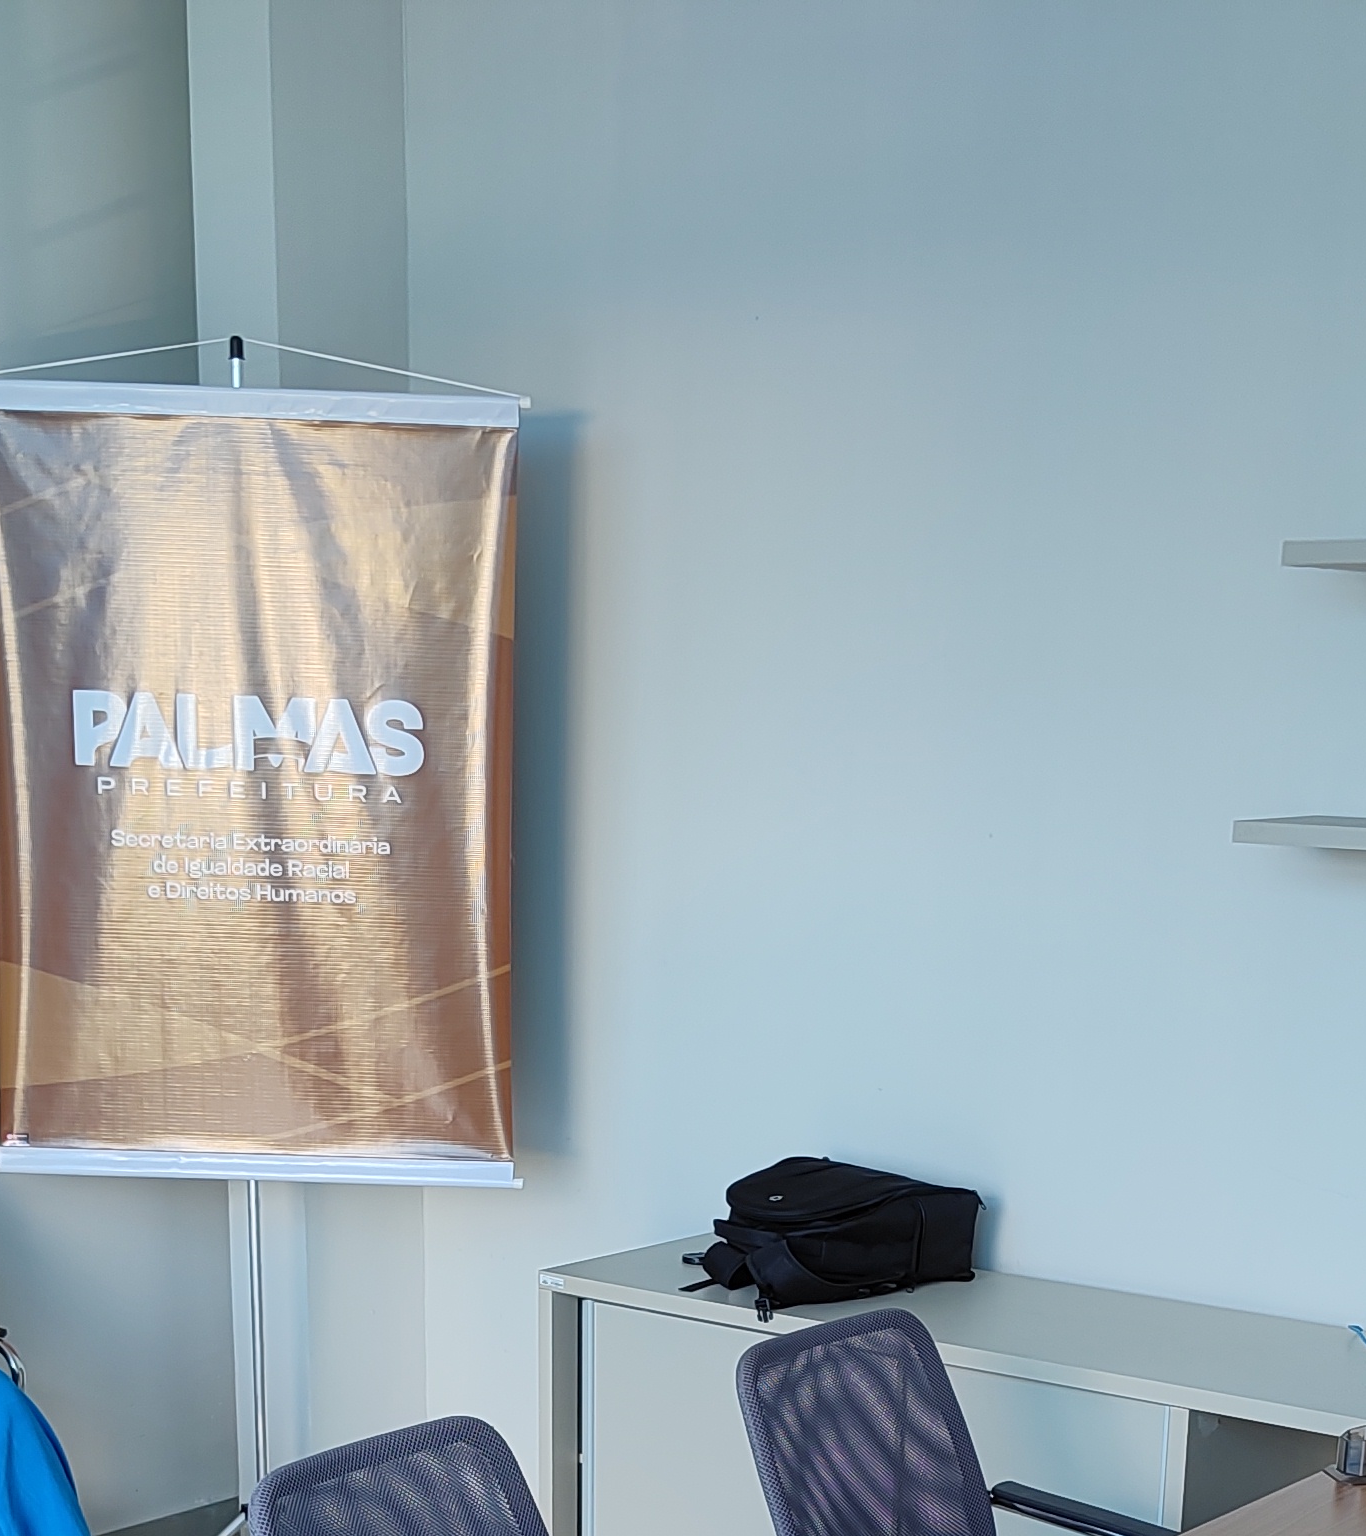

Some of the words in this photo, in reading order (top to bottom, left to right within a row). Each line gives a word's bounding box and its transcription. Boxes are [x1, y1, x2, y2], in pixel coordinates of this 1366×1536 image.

[72, 688, 425, 777] PALMAS
[96, 776, 402, 804] PREFEITURA
[110, 828, 229, 853] Secretaria
[233, 833, 392, 857] Extraordinária
[152, 856, 181, 876] de
[184, 857, 283, 880] Igualdade
[288, 860, 350, 881] Racial
[147, 884, 160, 898] e
[166, 881, 251, 902] Direitos
[257, 883, 357, 905] Humanos
